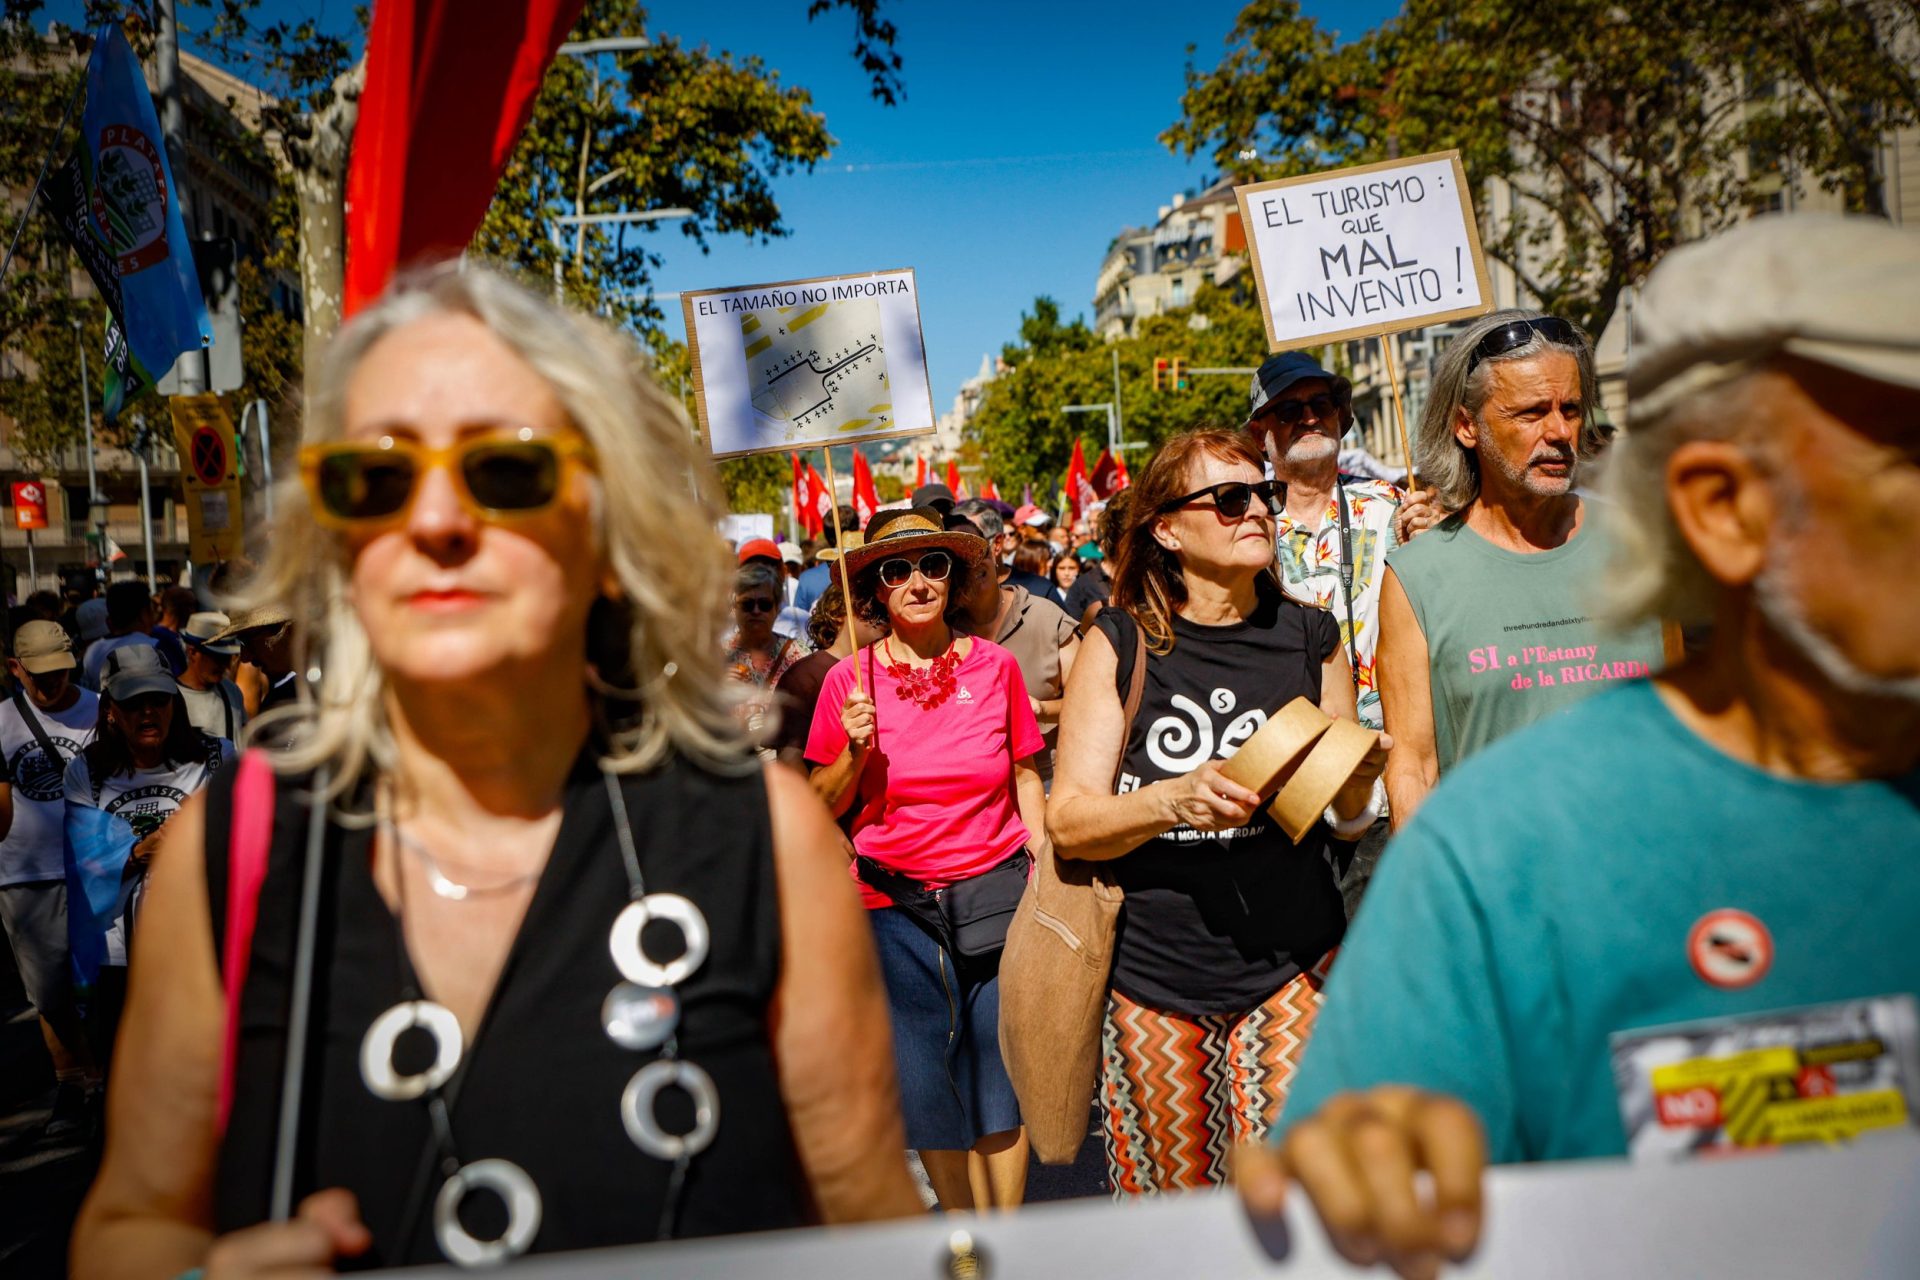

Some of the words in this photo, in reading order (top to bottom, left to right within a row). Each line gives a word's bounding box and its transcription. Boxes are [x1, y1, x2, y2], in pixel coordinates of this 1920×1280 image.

[1262, 198, 1303, 228] EL
[1312, 176, 1425, 218] TURISMO
[1341, 213, 1383, 234] QUE
[1319, 234, 1418, 280] MAL
[700, 302, 717, 316] EL
[720, 290, 797, 313] TAMAÑO
[803, 288, 826, 304] NO
[832, 279, 909, 300] IMPORTA
[1297, 268, 1441, 322] INVENTO
[1468, 645, 1501, 673] SI
[1507, 655, 1518, 667] a
[1523, 644, 1598, 664] l'Estany
[1511, 673, 1533, 690] de
[1538, 670, 1555, 687] la
